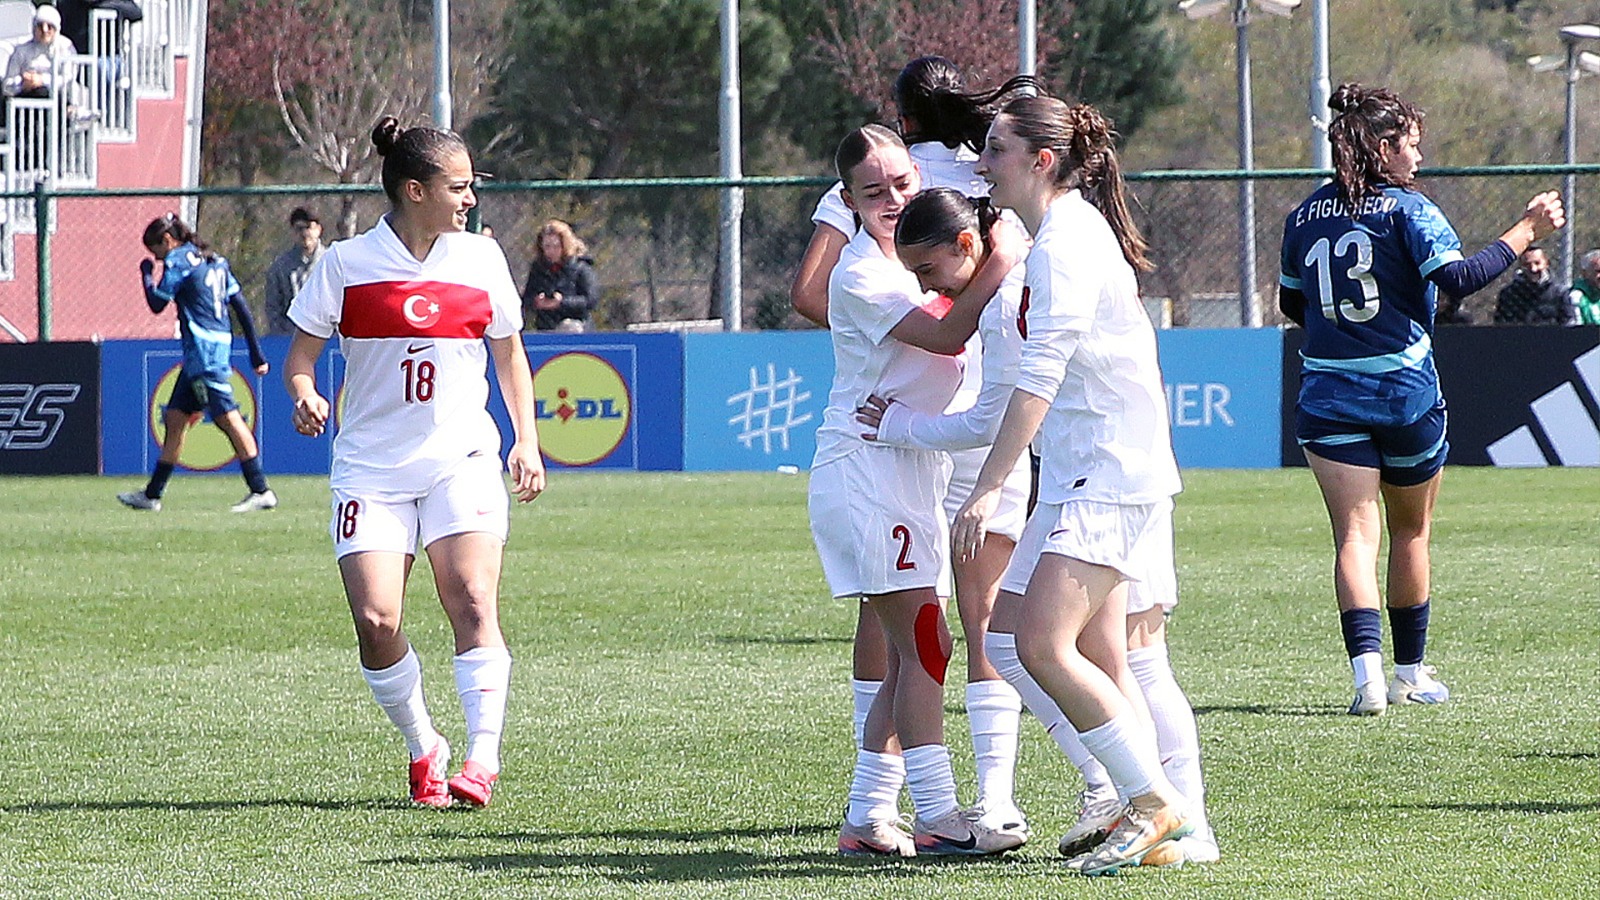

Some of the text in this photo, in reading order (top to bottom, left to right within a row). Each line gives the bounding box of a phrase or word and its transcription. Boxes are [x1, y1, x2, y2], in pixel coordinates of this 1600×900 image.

[1304, 230, 1380, 323] 13
[400, 359, 436, 404] 18
[335, 499, 360, 545] 18
[892, 524, 917, 571] 2
